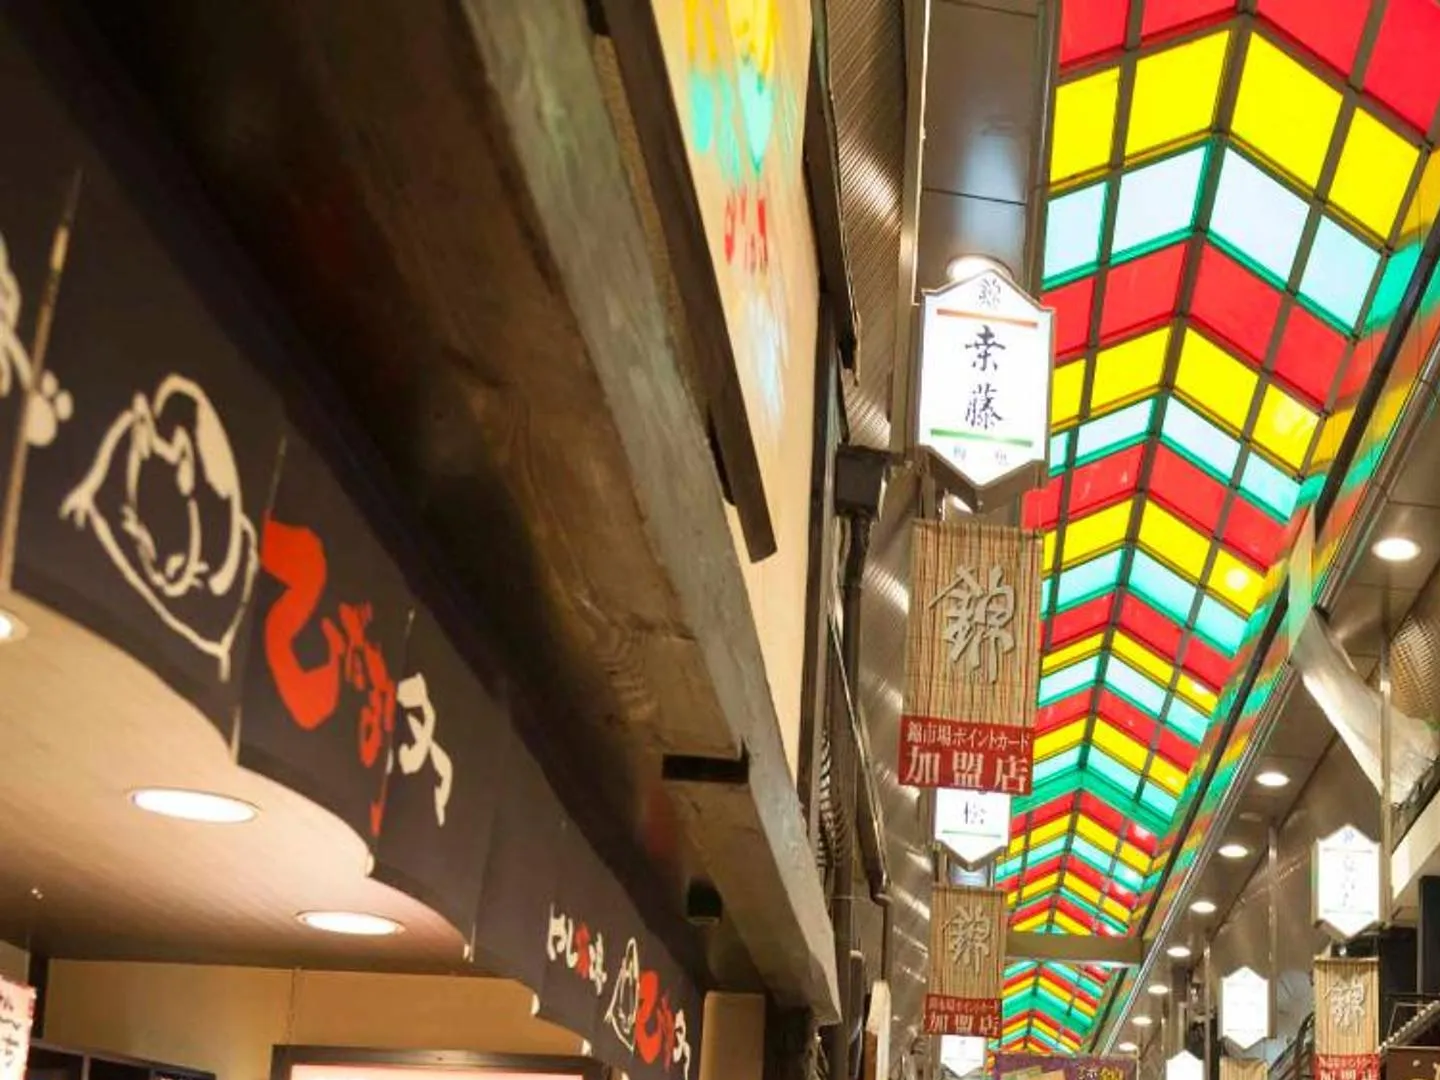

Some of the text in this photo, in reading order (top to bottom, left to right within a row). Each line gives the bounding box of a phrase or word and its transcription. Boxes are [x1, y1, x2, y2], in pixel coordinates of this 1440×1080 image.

[929, 564, 1016, 684] 錦
[907, 720, 1030, 750] 錦市場ポイントカード
[905, 745, 1030, 794] 加盟店
